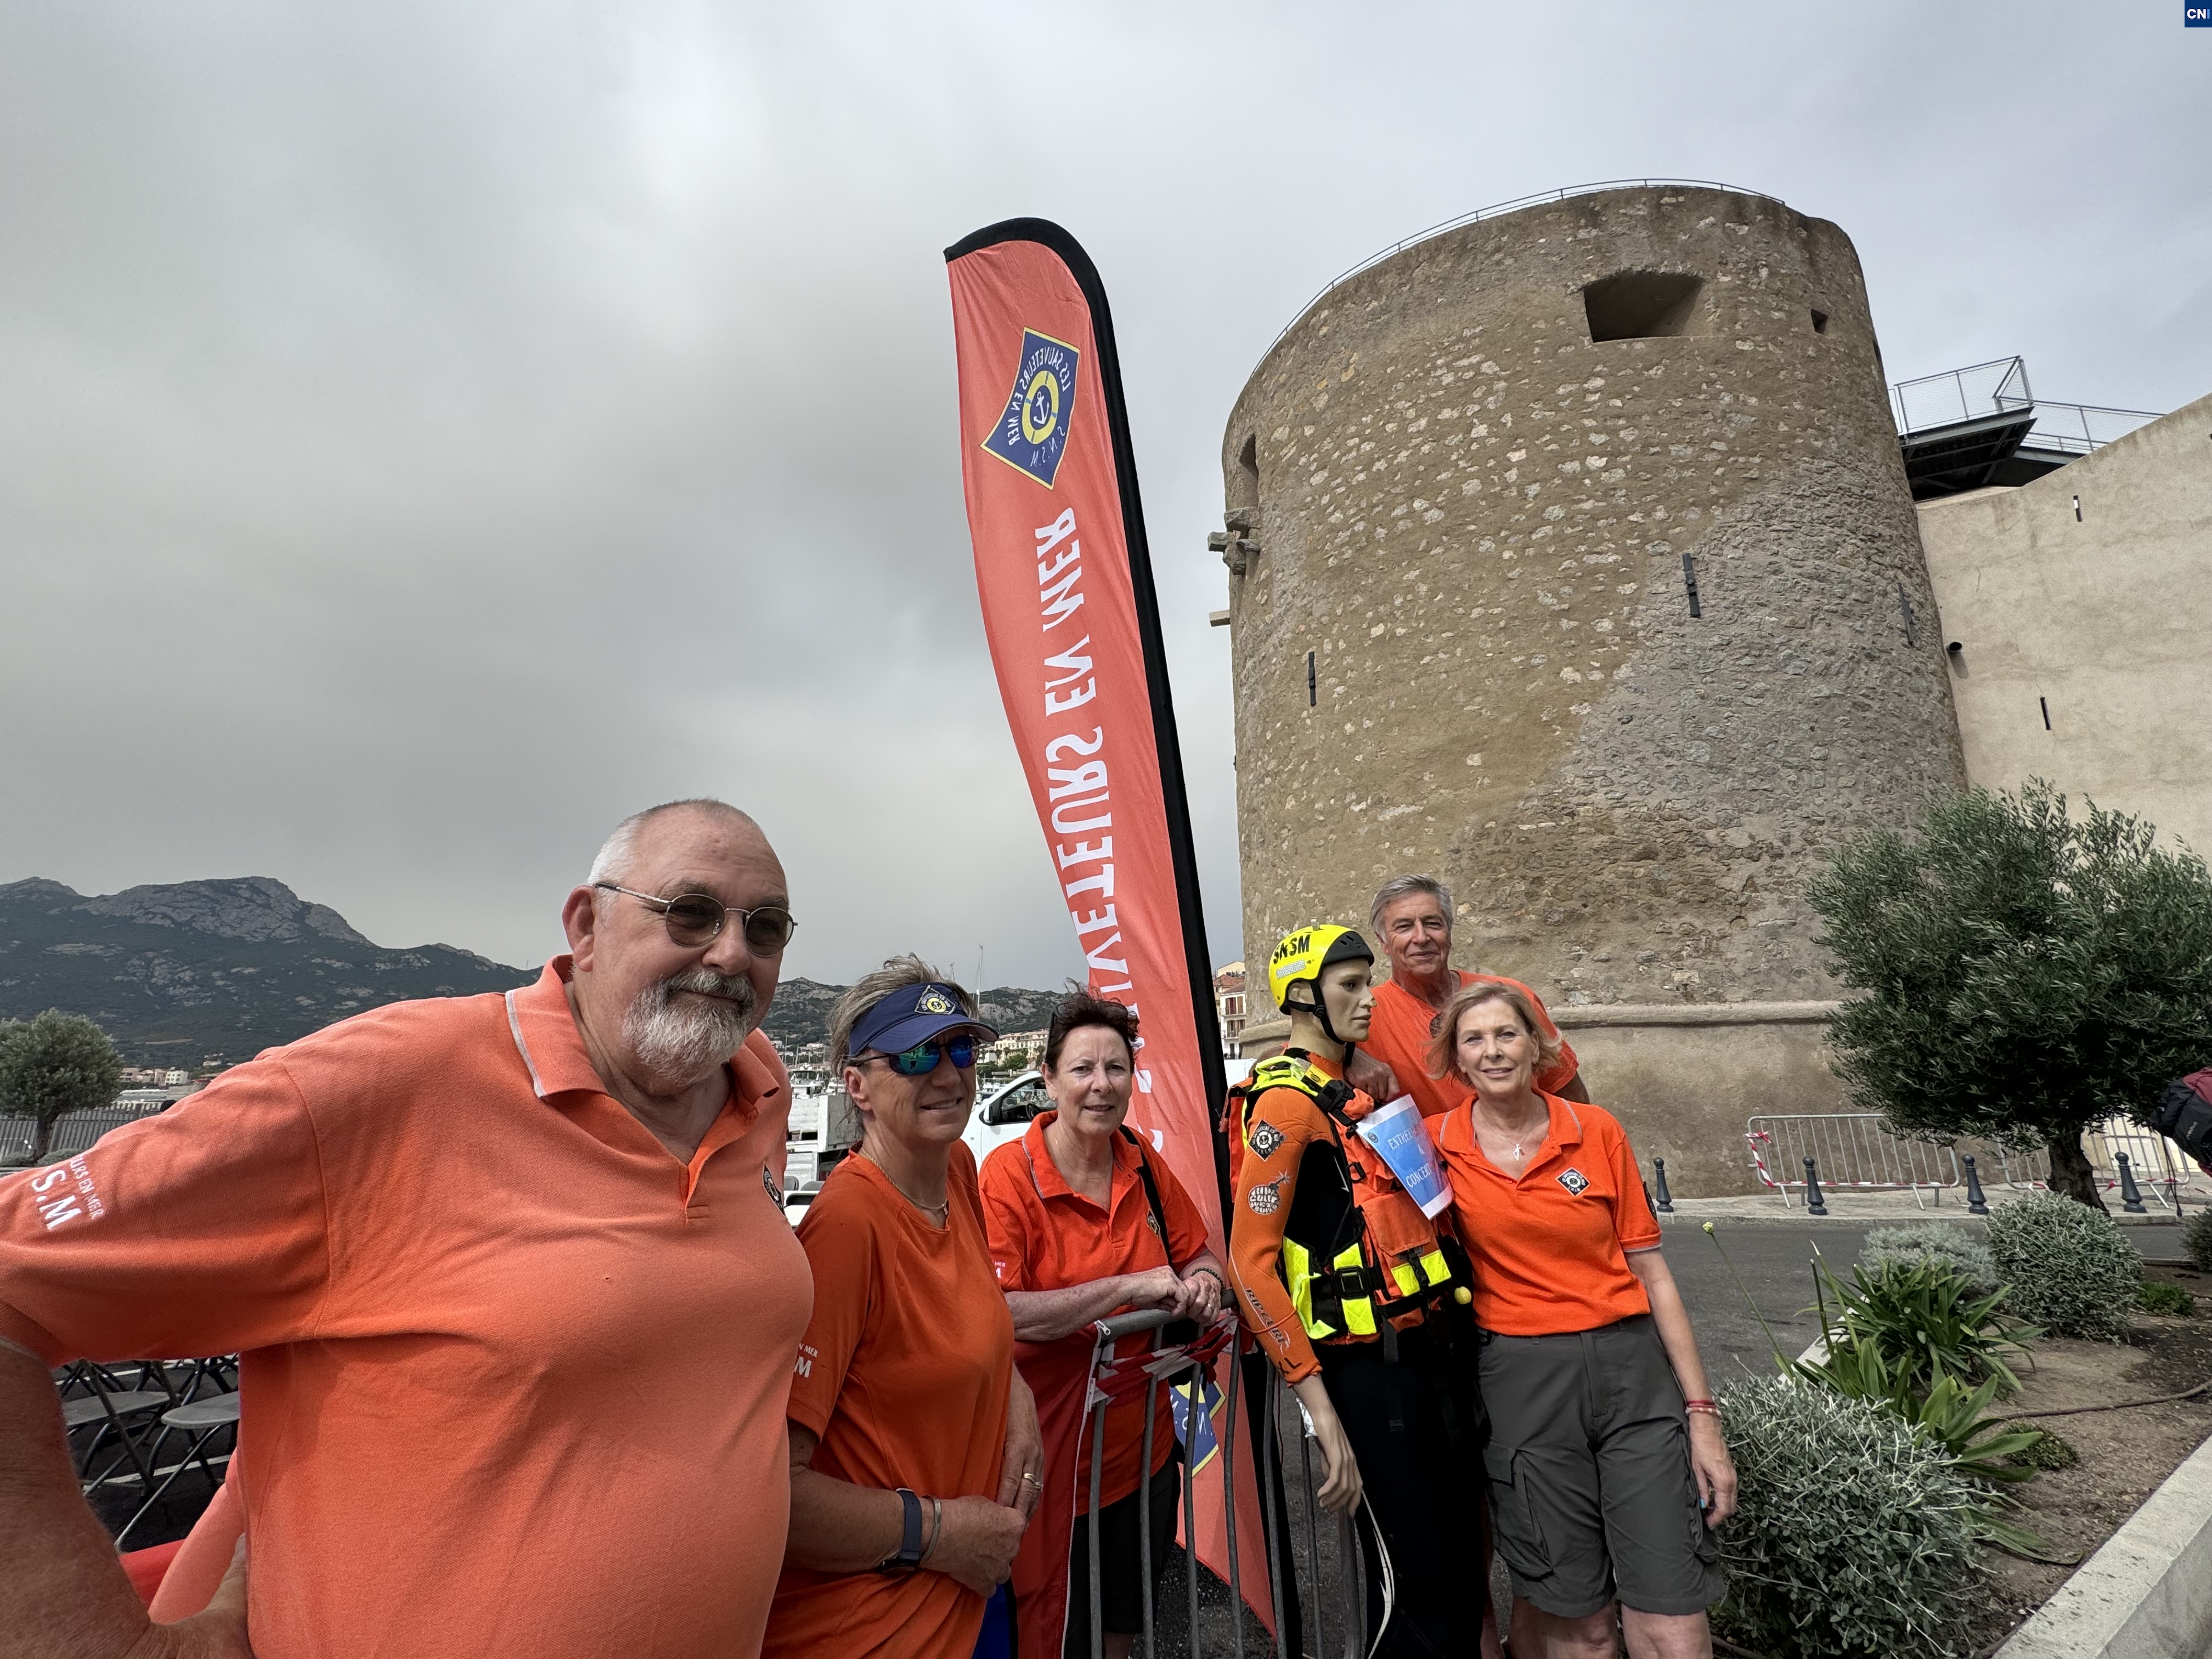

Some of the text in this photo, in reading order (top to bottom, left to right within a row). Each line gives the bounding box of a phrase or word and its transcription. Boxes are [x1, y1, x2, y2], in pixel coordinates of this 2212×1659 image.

[1273, 934, 1311, 965] SNSM
[70, 1154, 106, 1221] URS EN MER
[1406, 1163, 1433, 1189] CONCERT
[1276, 1357, 1302, 1377] XL
